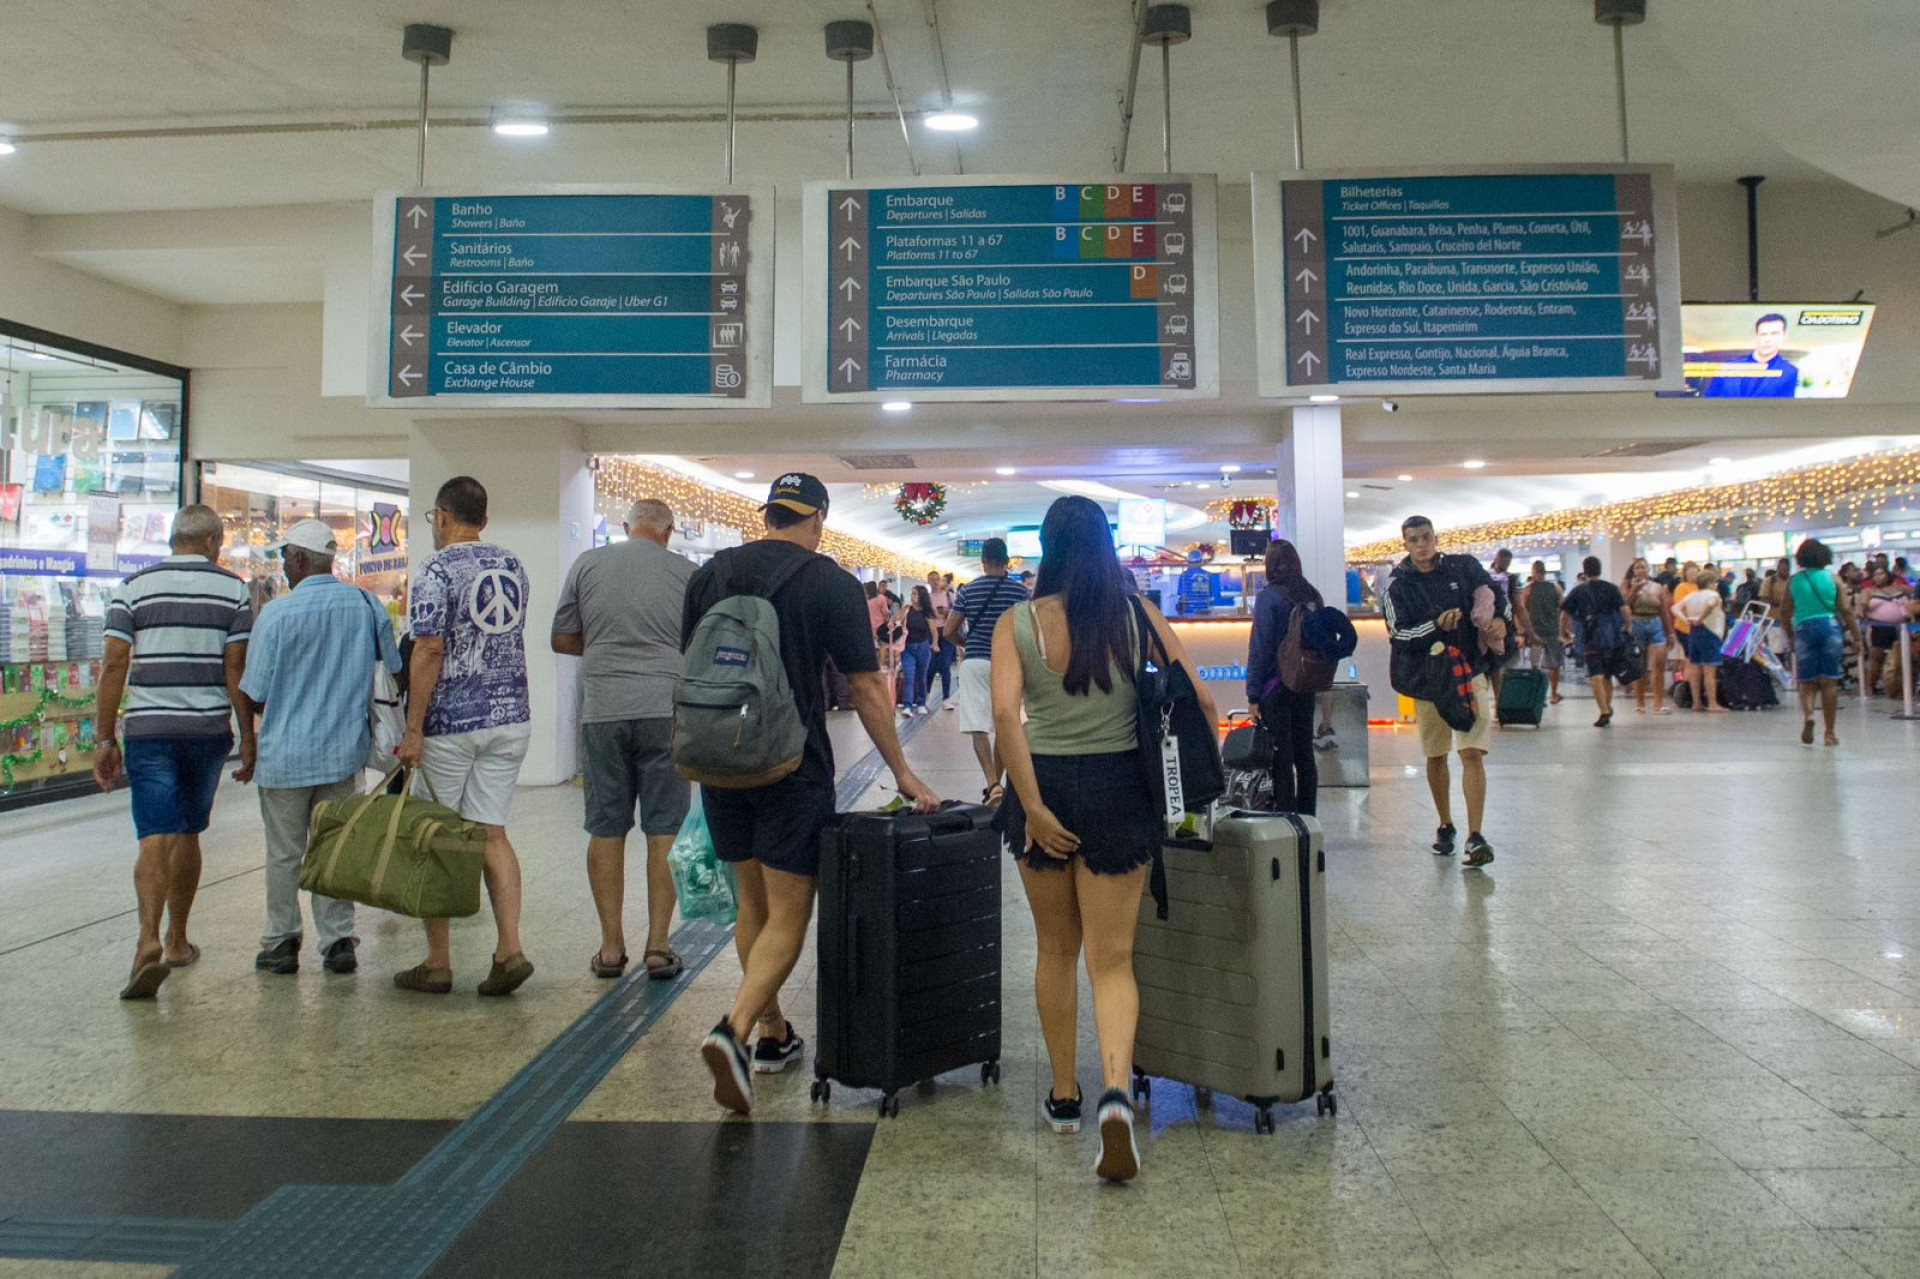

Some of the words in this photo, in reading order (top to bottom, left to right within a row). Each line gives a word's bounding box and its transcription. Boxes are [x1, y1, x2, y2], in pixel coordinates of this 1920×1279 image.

[887, 195, 954, 209] Embarque
[1055, 187, 1066, 200] B
[1081, 186, 1092, 200] C
[1108, 186, 1119, 200] D
[1132, 187, 1143, 202] E
[1341, 186, 1403, 198] Bilheterias
[451, 203, 492, 215] Banho
[1342, 201, 1369, 211] Ticket
[1371, 201, 1402, 211] Offices
[1408, 200, 1449, 212] Taquillas
[887, 210, 943, 221] Departures
[950, 209, 986, 220] Salidas
[451, 218, 492, 228] Showers
[500, 218, 525, 228] Baño
[1342, 226, 1369, 238] 1001,
[1371, 225, 1426, 237] Guanabara,
[1429, 224, 1455, 236] Brisa,
[1458, 223, 1490, 236] Penha,
[1493, 223, 1527, 235] Pluma,
[1529, 221, 1569, 235] Cometa,
[887, 234, 958, 247] Plataformas
[962, 234, 973, 247] 11
[978, 237, 985, 246] a
[988, 234, 1003, 247] 67
[1055, 227, 1066, 240] B
[1081, 227, 1092, 241] C
[1108, 227, 1120, 240] D
[1132, 227, 1143, 243] E
[450, 242, 512, 254] Sanitários
[1343, 241, 1386, 254] Salutaris,
[1389, 241, 1433, 254] Sampaio,
[1477, 240, 1492, 250] del
[1494, 240, 1521, 250] Norte
[887, 250, 936, 261] Platforms
[939, 250, 949, 260] 11
[952, 250, 962, 260] to
[964, 249, 978, 260] 67
[450, 258, 500, 268] Restrooms
[508, 257, 534, 267] Baño
[1346, 264, 1402, 276] Andorinha,
[1405, 263, 1459, 276] Paraibuna,
[1461, 263, 1518, 275] Transnorte,
[1521, 262, 1565, 276] Expresso
[1566, 261, 1599, 275] União,
[886, 276, 949, 289] Embarque
[952, 275, 974, 287] São
[977, 275, 1010, 287] Paulo
[1133, 266, 1146, 280] D
[496, 281, 558, 296] Garagem
[1347, 282, 1396, 295] Reunidas,
[1399, 282, 1415, 294] Rio
[1418, 282, 1445, 295] Doce,
[1448, 281, 1481, 294] Unida,
[1483, 280, 1517, 293] Garcia,
[1520, 279, 1539, 292] São
[1541, 280, 1588, 292] Cristóvão
[886, 289, 943, 301] Departures
[946, 289, 964, 300] São
[966, 289, 996, 299] Paulo
[1004, 288, 1039, 299] Salidas
[1042, 288, 1061, 298] São
[1063, 288, 1093, 298] Paulo
[443, 297, 483, 308] Garage
[486, 297, 530, 309] Building
[580, 297, 616, 309] Garaje
[625, 296, 651, 307] Uber
[654, 296, 668, 307] G1
[1344, 306, 1369, 318] Novo
[1371, 306, 1420, 318] Horizonte,
[1423, 304, 1482, 317] Catarinense,
[1484, 303, 1536, 316] Roderotas,
[1538, 303, 1577, 315] Entram,
[447, 322, 502, 334] Elevador
[886, 315, 973, 330] Desembarque
[1345, 322, 1386, 336] Expresso
[1389, 322, 1400, 334] do
[1404, 321, 1422, 334] Sul,
[1424, 321, 1478, 334] Itapemirim
[447, 338, 484, 347] Elevator
[490, 338, 531, 347] Ascensor
[887, 330, 924, 341] Arrivals
[932, 330, 978, 342] Llegadas
[1346, 348, 1366, 360] Real
[1369, 348, 1413, 362] Expresso,
[1415, 347, 1452, 361] Gontijo,
[1456, 346, 1499, 360] Nacional,
[1502, 344, 1530, 360] Águia
[1532, 346, 1569, 358] Branca,
[444, 361, 475, 375] Casa
[479, 361, 496, 375] de
[500, 361, 552, 375] Câmbio
[885, 354, 947, 368] Farmácia
[886, 370, 943, 382] Pharmacy
[1346, 365, 1387, 378] Expresso
[1390, 364, 1436, 377] Nordeste,
[1439, 363, 1465, 375] Santa
[1469, 363, 1496, 375] Maria
[445, 377, 498, 390] Exchange
[500, 377, 535, 388] House
[1166, 756, 1182, 816] TROPEA
